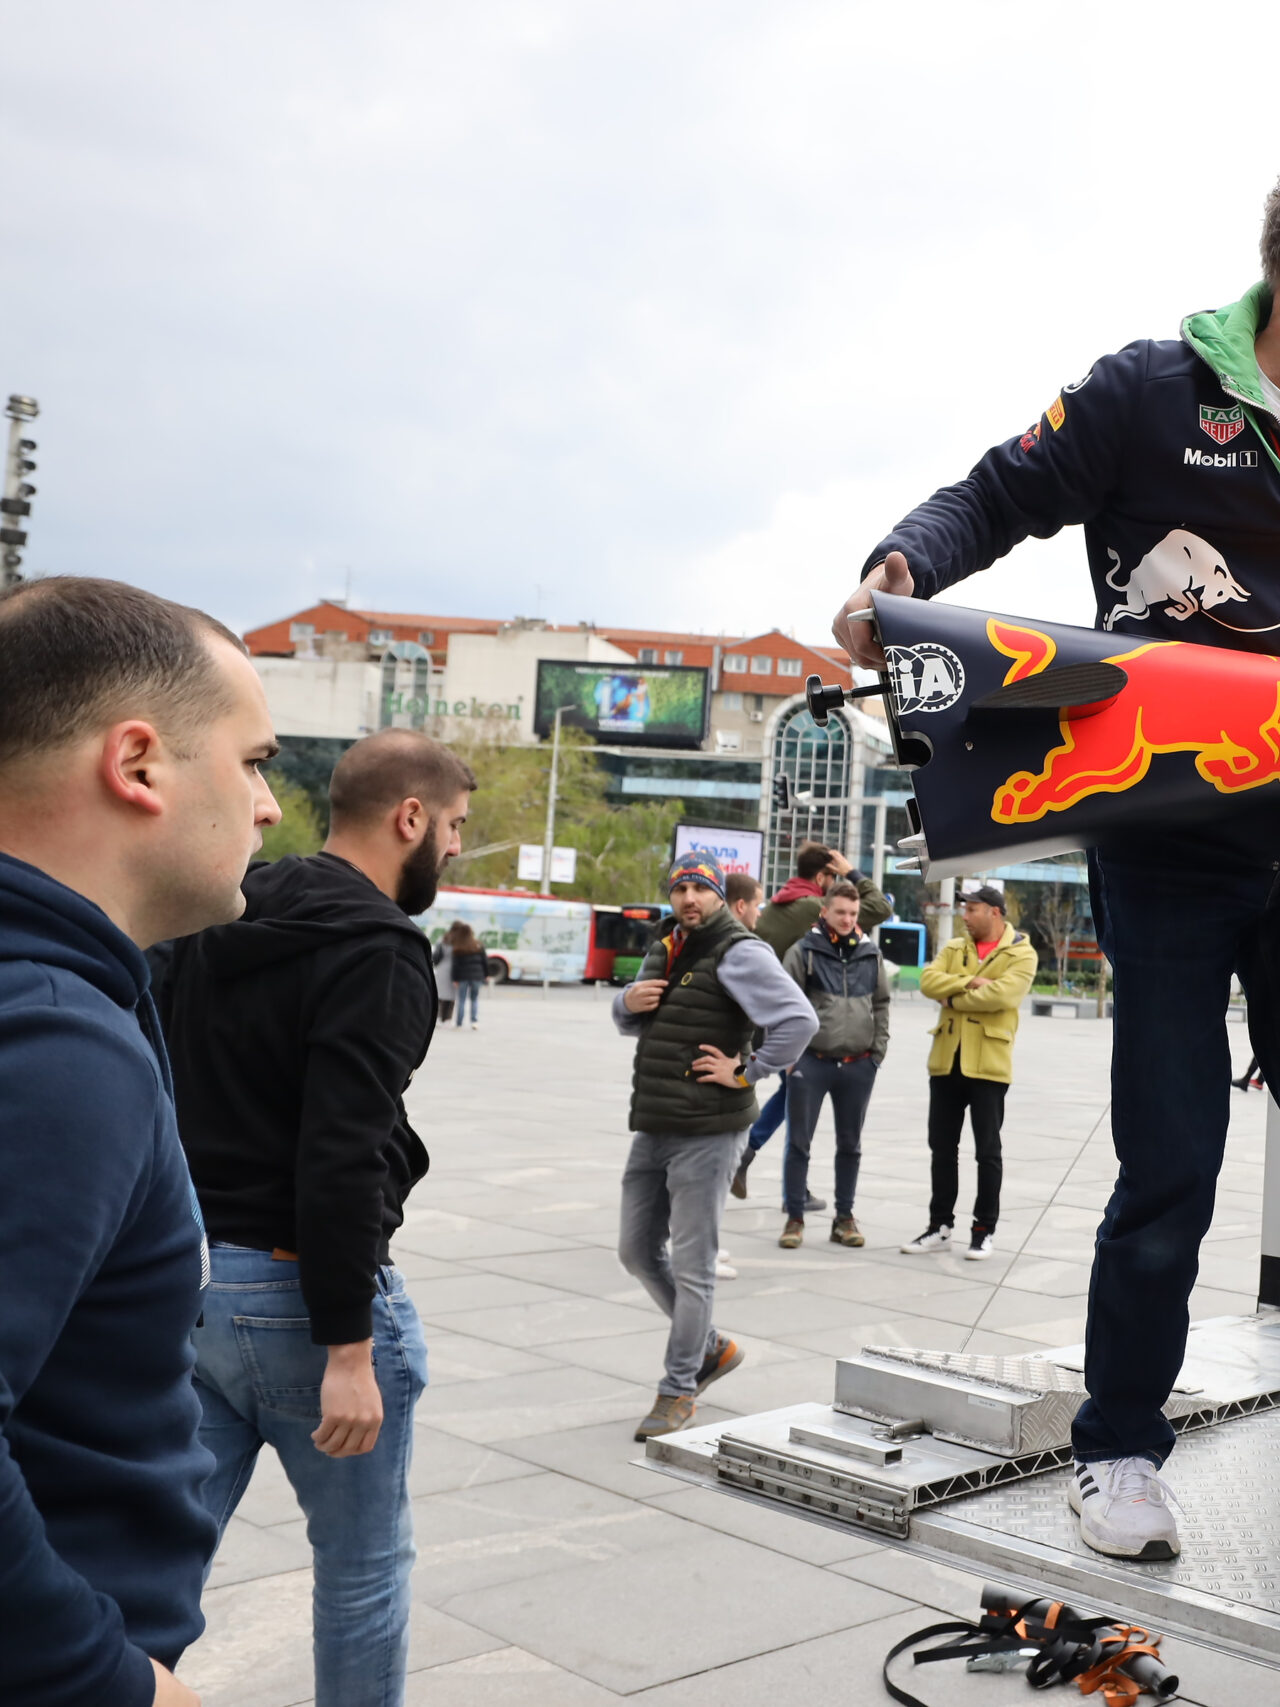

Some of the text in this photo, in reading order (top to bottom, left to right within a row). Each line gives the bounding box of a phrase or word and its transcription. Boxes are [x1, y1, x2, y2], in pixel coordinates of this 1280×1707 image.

[1203, 407, 1240, 421] TAG
[1202, 421, 1242, 442] HEUER
[1183, 447, 1237, 467] Mobil
[386, 691, 521, 721] Heineken
